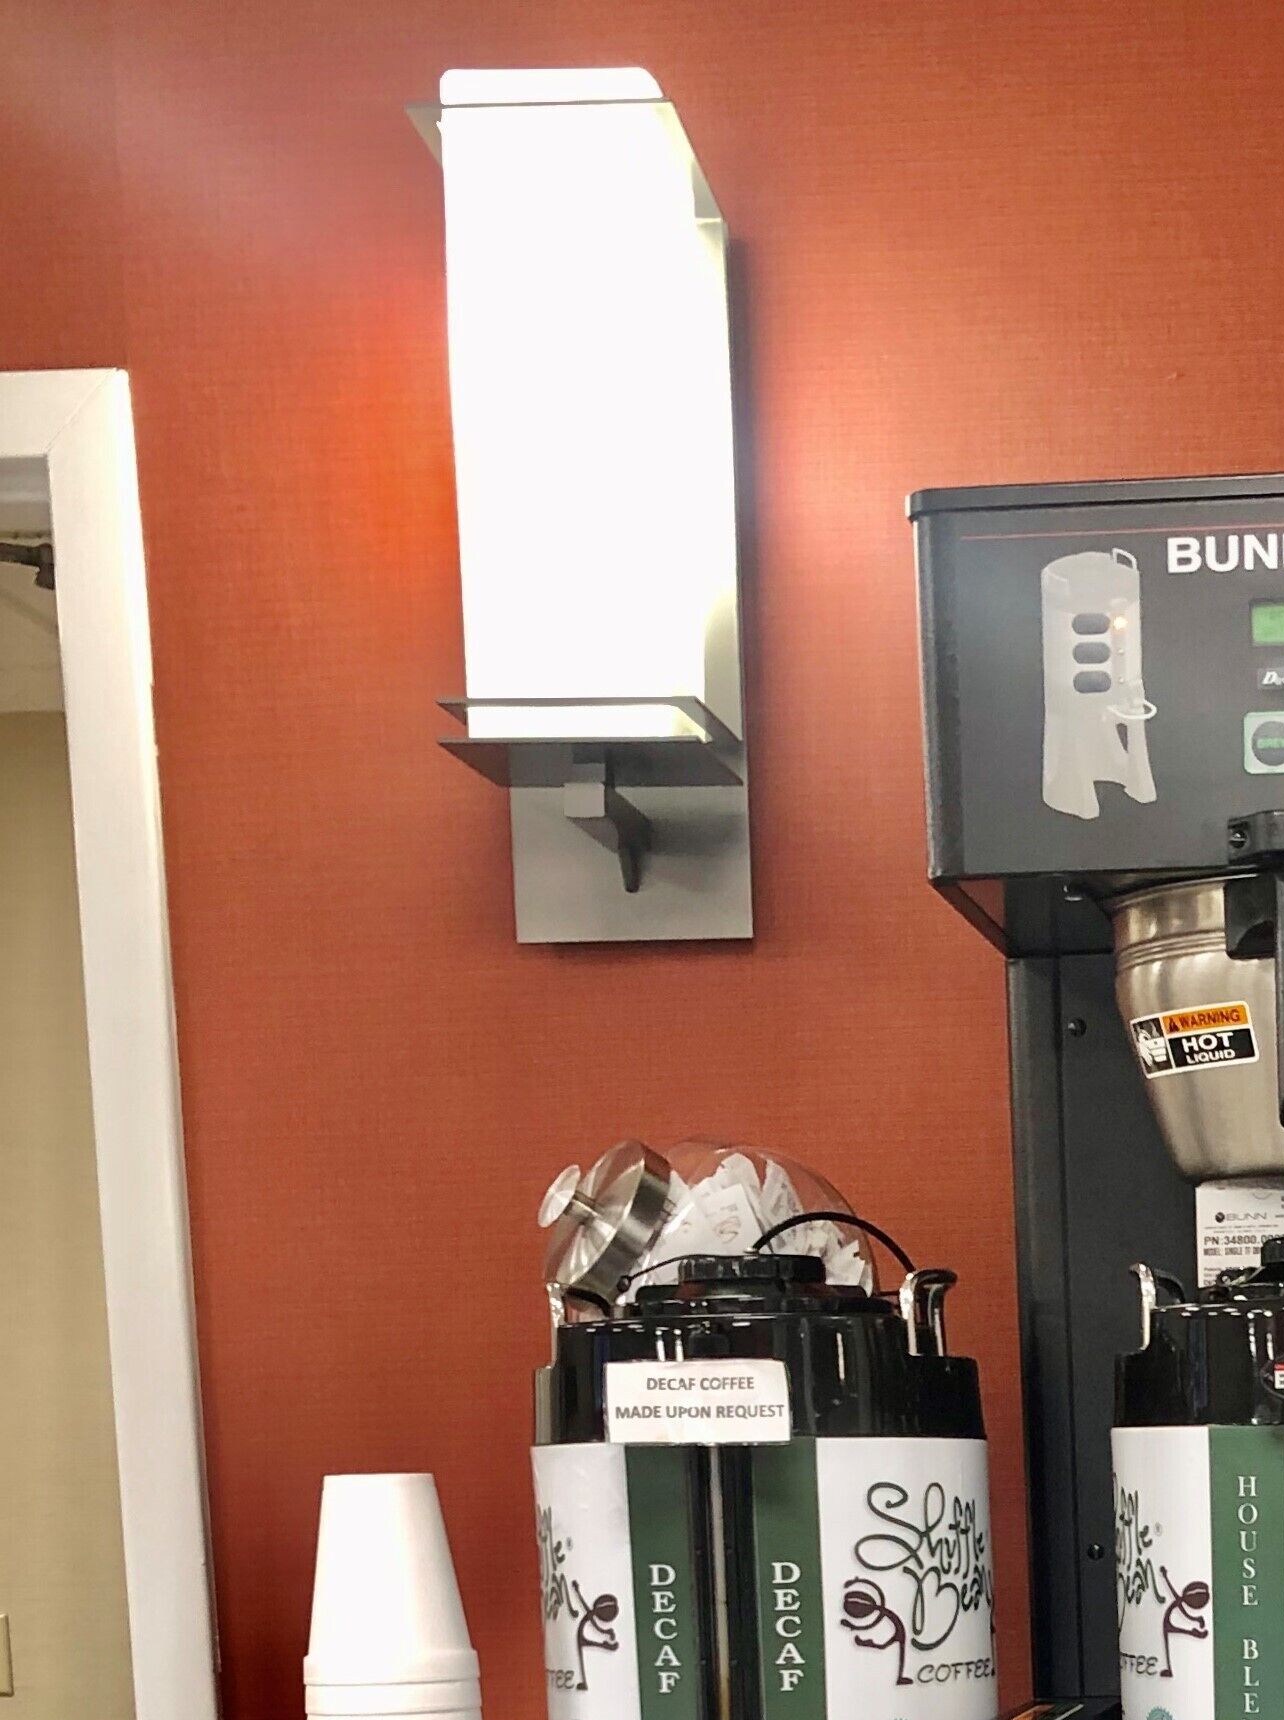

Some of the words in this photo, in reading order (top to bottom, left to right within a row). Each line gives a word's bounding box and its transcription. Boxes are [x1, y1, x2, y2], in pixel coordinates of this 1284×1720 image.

[1179, 1008, 1240, 1028] WARNING
[1181, 1031, 1234, 1053] HOT
[1185, 1048, 1236, 1064] LIQUID
[647, 1377, 696, 1391] DECAF
[700, 1376, 755, 1390] COFFEE
[615, 1405, 662, 1419] MADE
[666, 1405, 712, 1419] UPON
[715, 1404, 785, 1419] REQUEST
[1237, 1476, 1260, 1607] HOUSE
[648, 1564, 681, 1694] DECAF
[772, 1561, 805, 1692] DECAF
[917, 1658, 991, 1684] COFFEE
